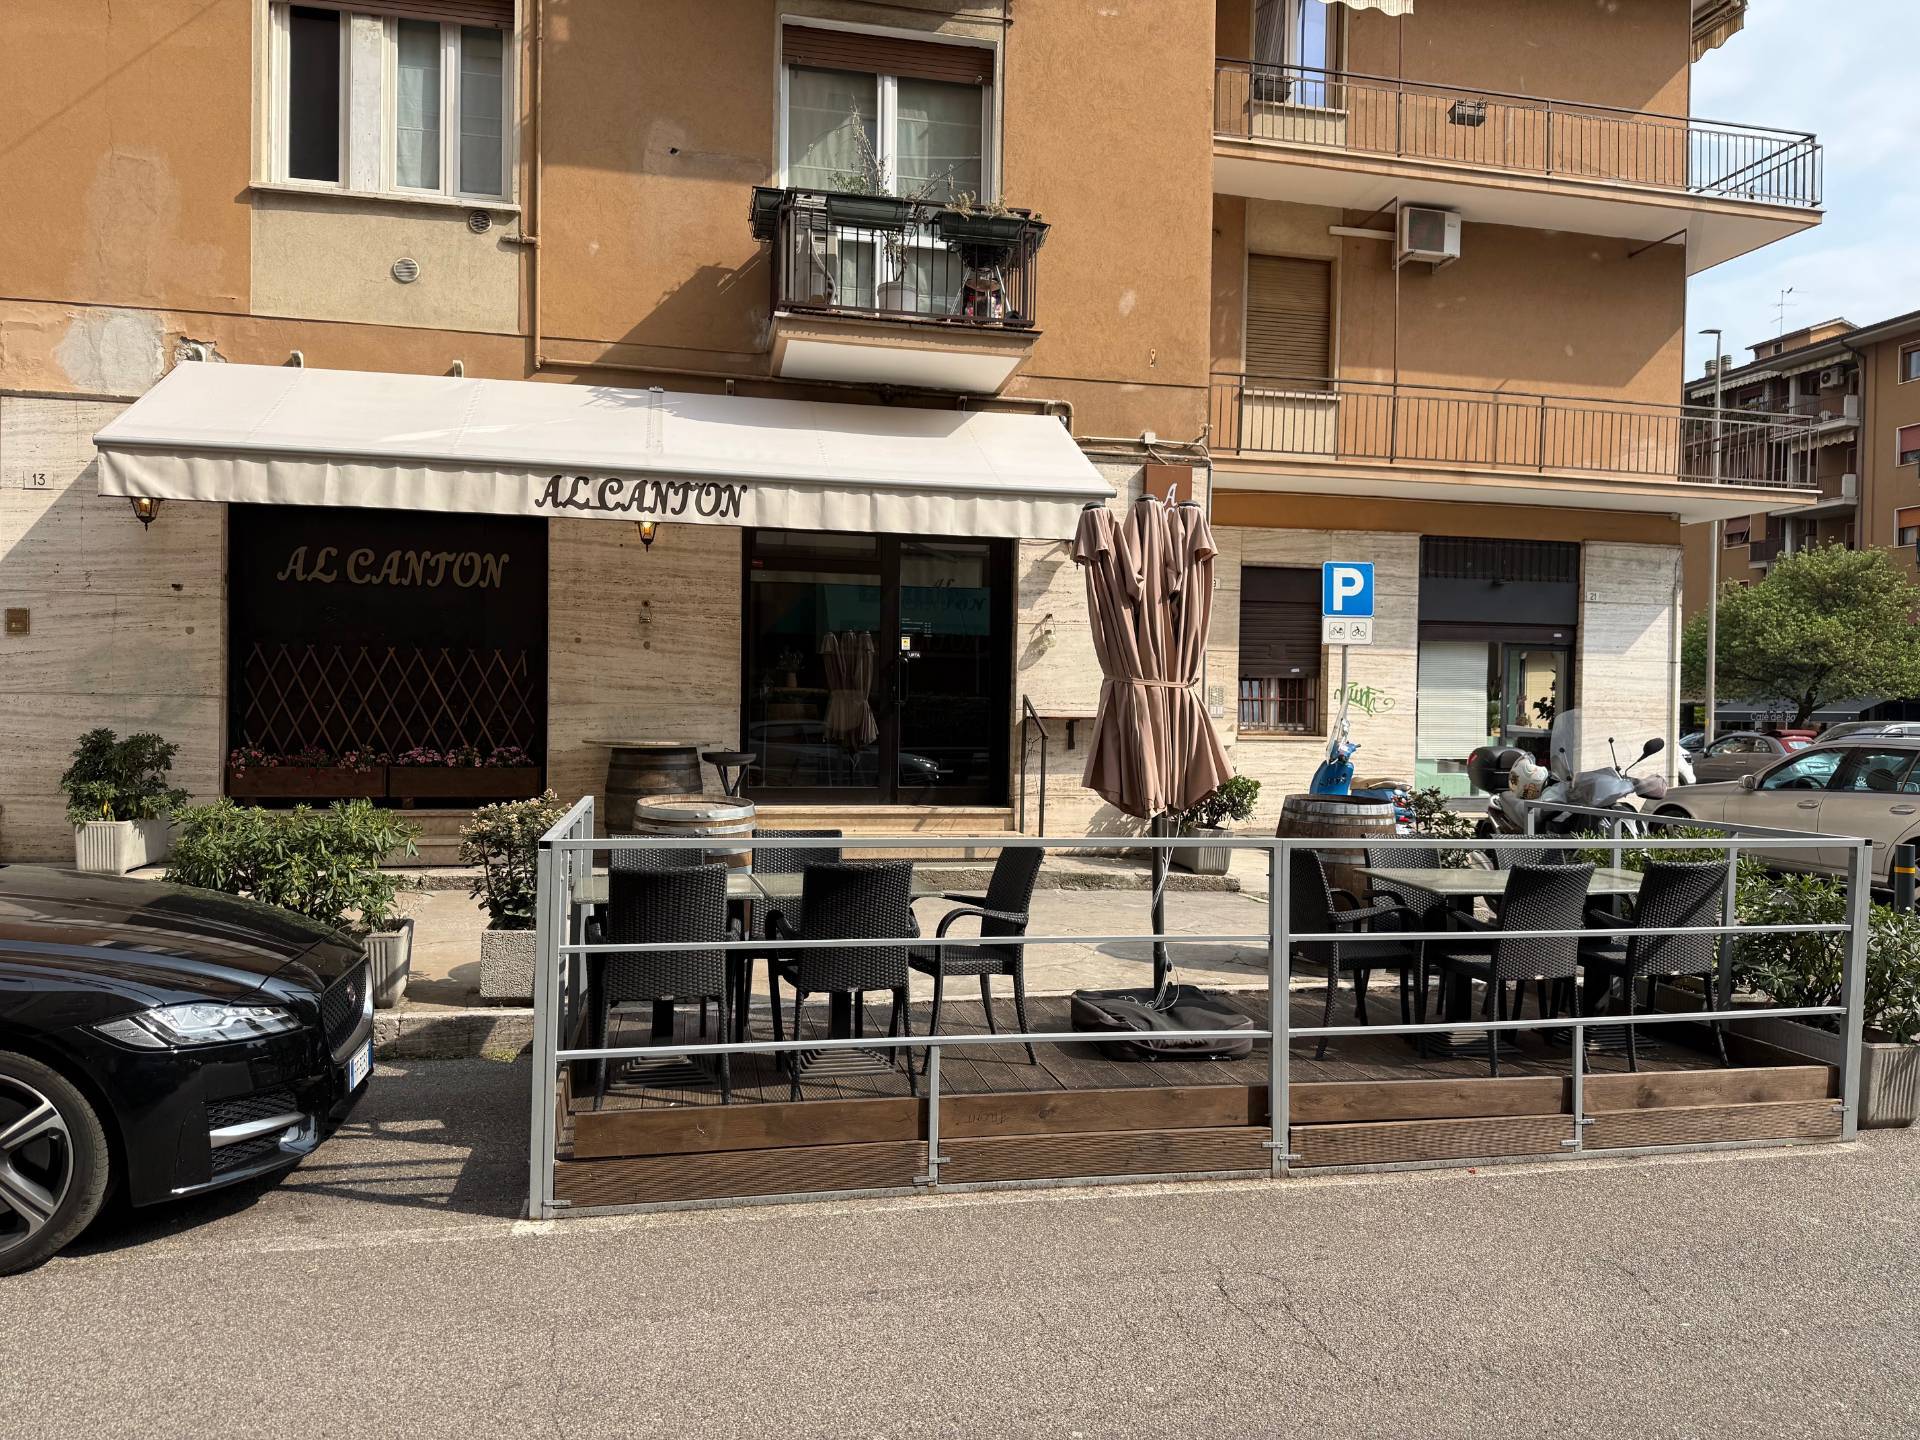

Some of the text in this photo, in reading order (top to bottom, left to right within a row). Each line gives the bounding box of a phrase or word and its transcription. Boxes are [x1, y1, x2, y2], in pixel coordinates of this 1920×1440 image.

[32, 473, 46, 486] 13
[535, 474, 748, 518] AL CANTON
[276, 546, 510, 588] AL CANTON
[1333, 568, 1364, 610] P
[1589, 592, 1597, 601] 21
